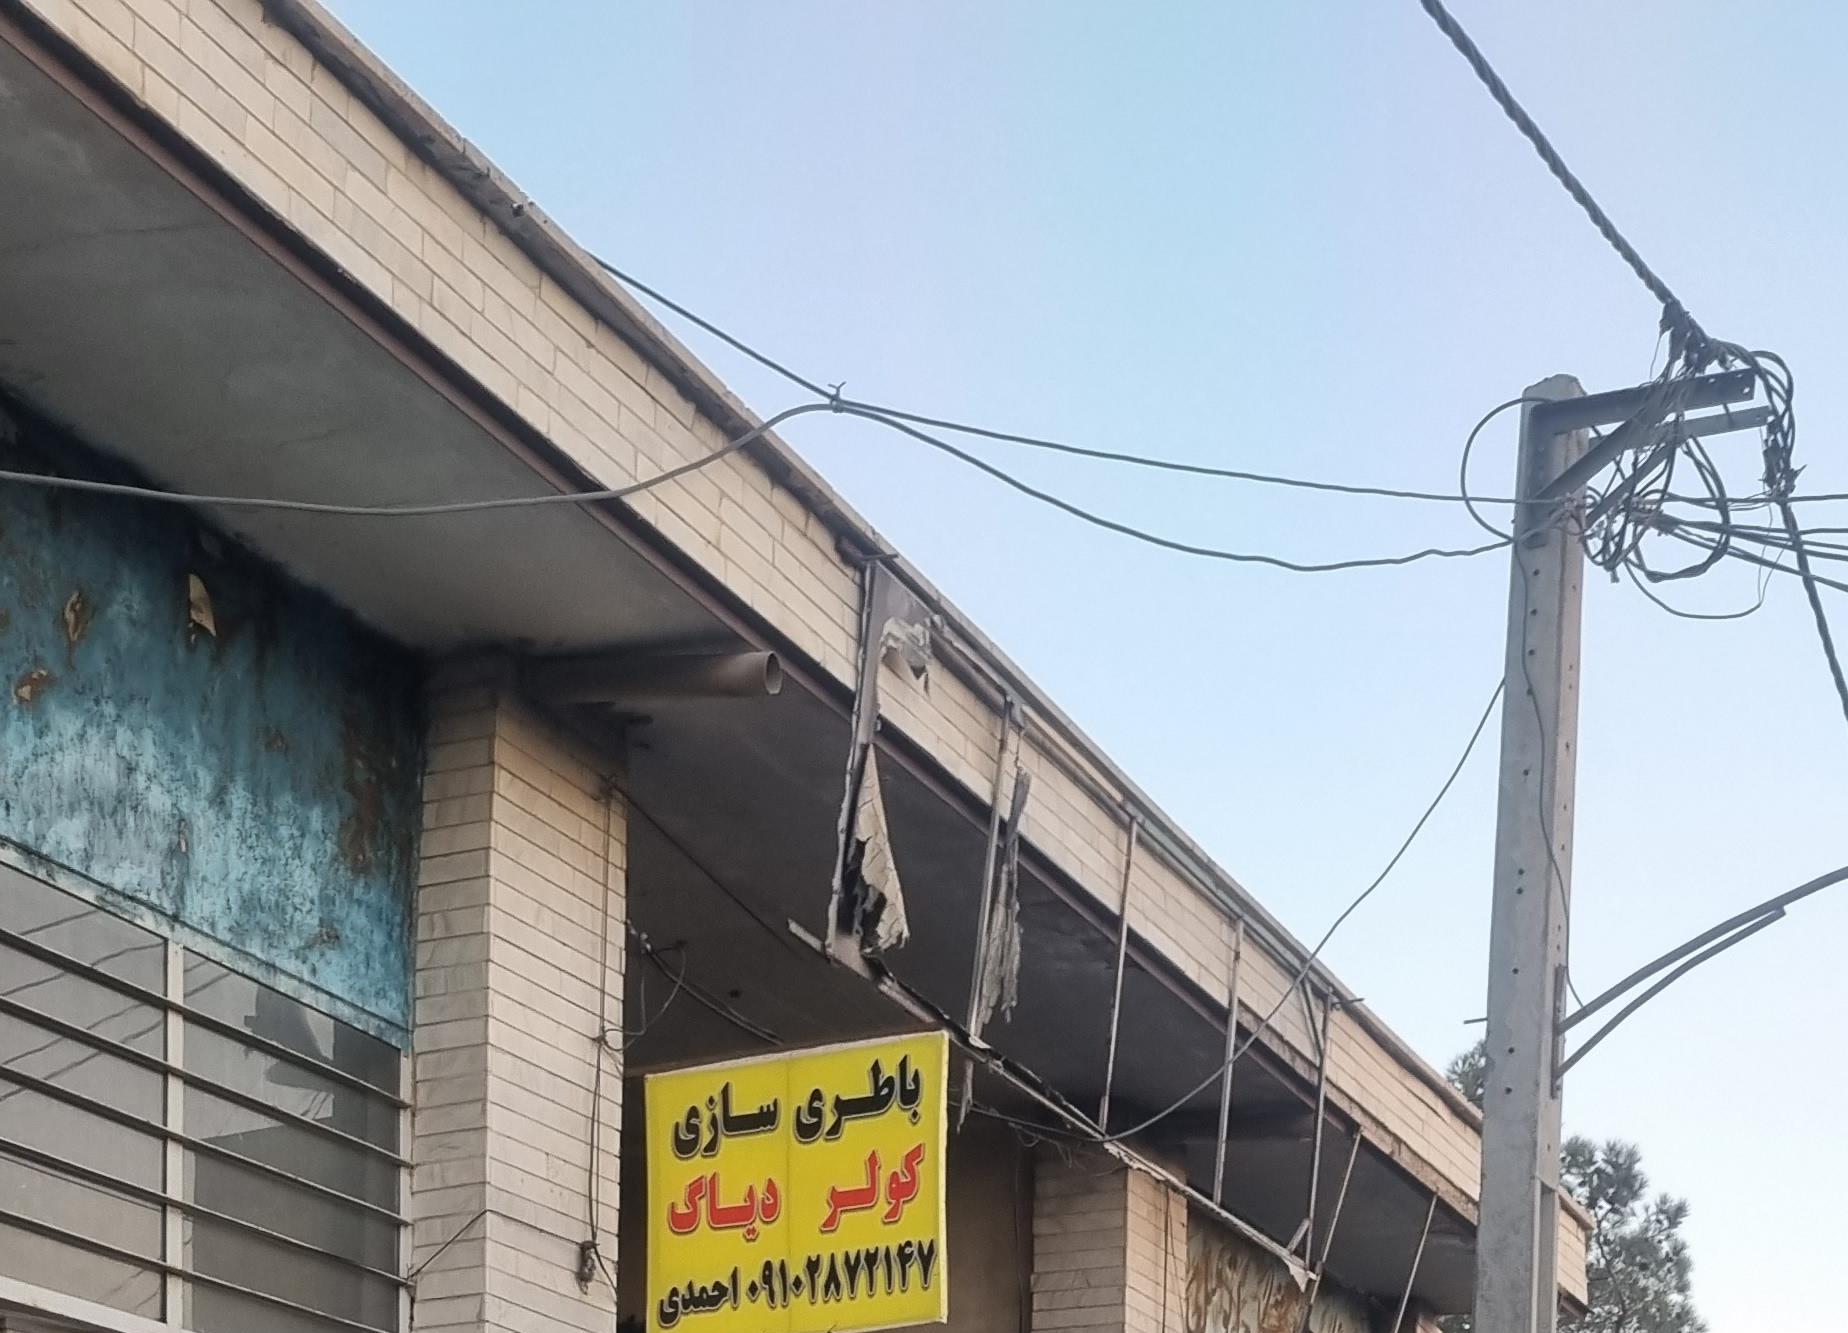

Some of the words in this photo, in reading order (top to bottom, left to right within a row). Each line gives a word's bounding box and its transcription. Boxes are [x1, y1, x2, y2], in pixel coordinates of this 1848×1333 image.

[673, 1082, 779, 1157] سازی
[796, 1055, 921, 1141] باطری
[668, 1170, 782, 1241] دیاگ
[820, 1143, 925, 1233] کولر
[657, 1266, 740, 1328] احمدی
